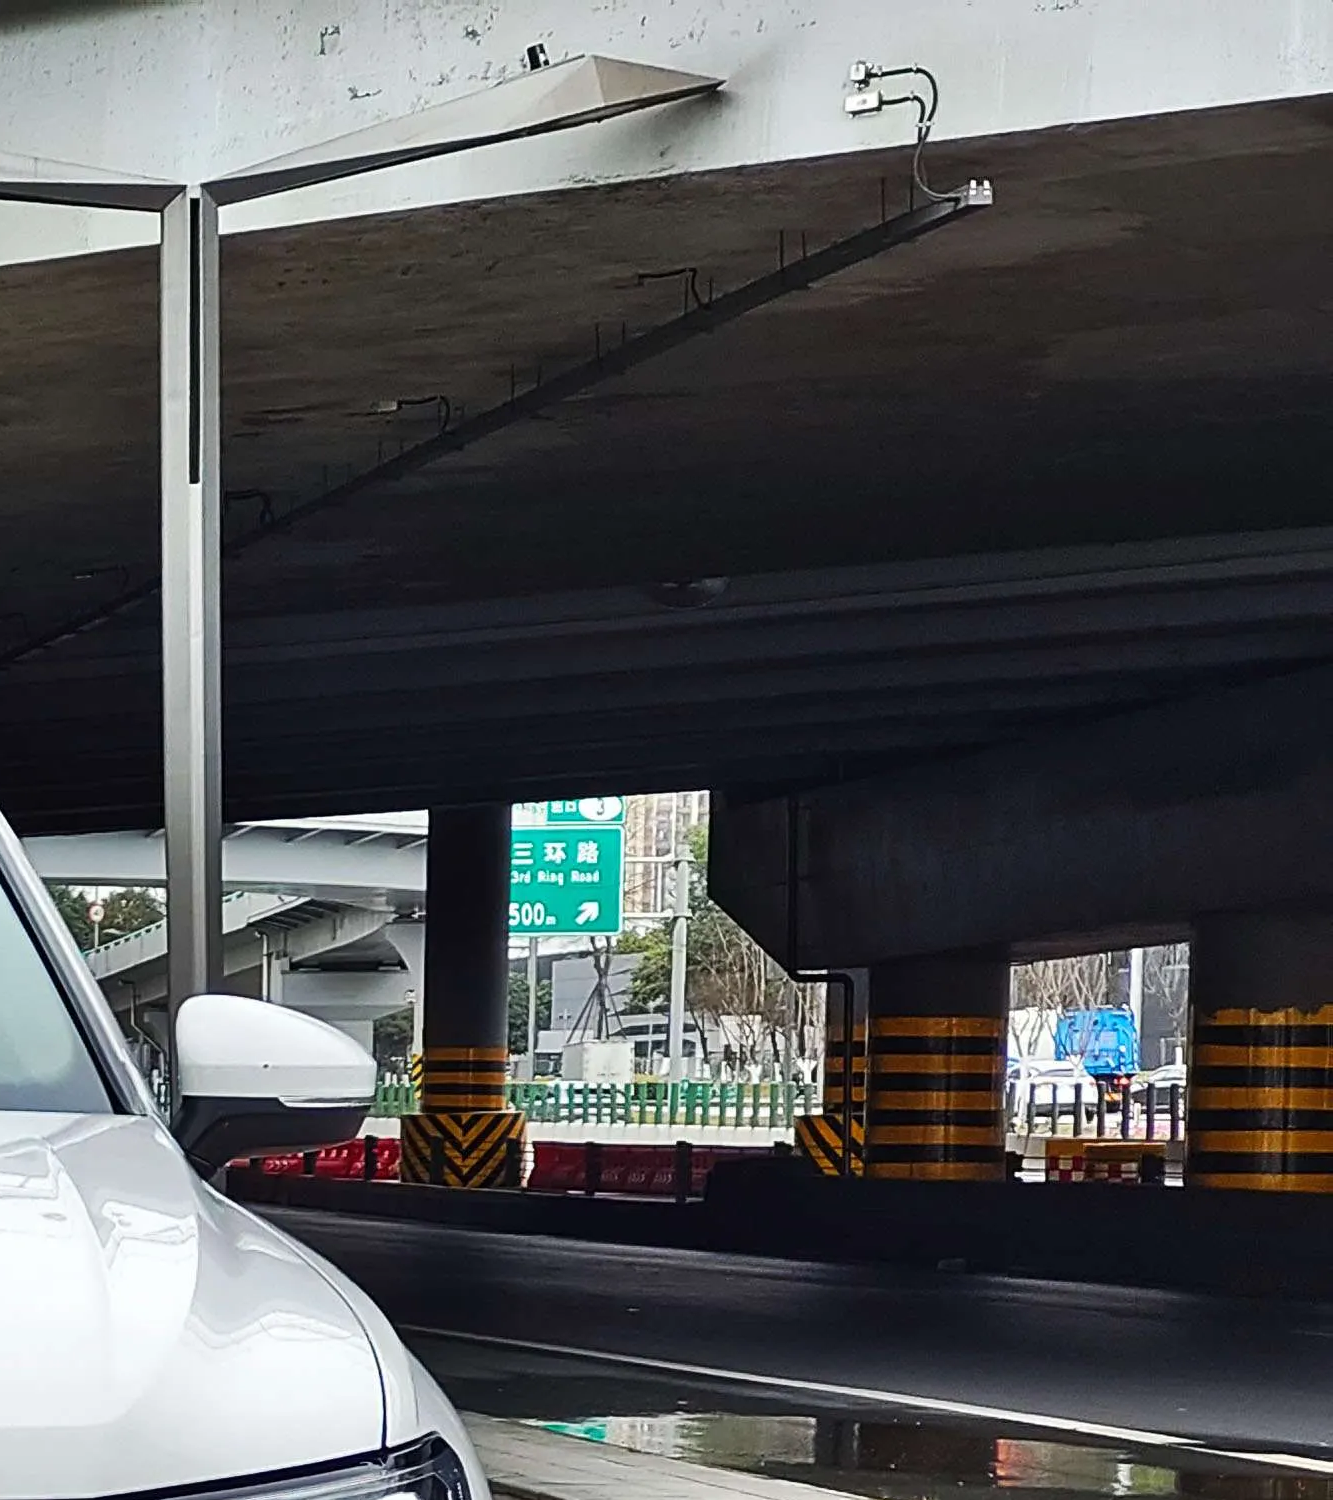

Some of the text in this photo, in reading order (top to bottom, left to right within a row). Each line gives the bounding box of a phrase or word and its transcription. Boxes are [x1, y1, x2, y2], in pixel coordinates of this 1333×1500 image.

[511, 841, 599, 864] 三环路
[511, 870, 600, 886] 3rd Ring Road
